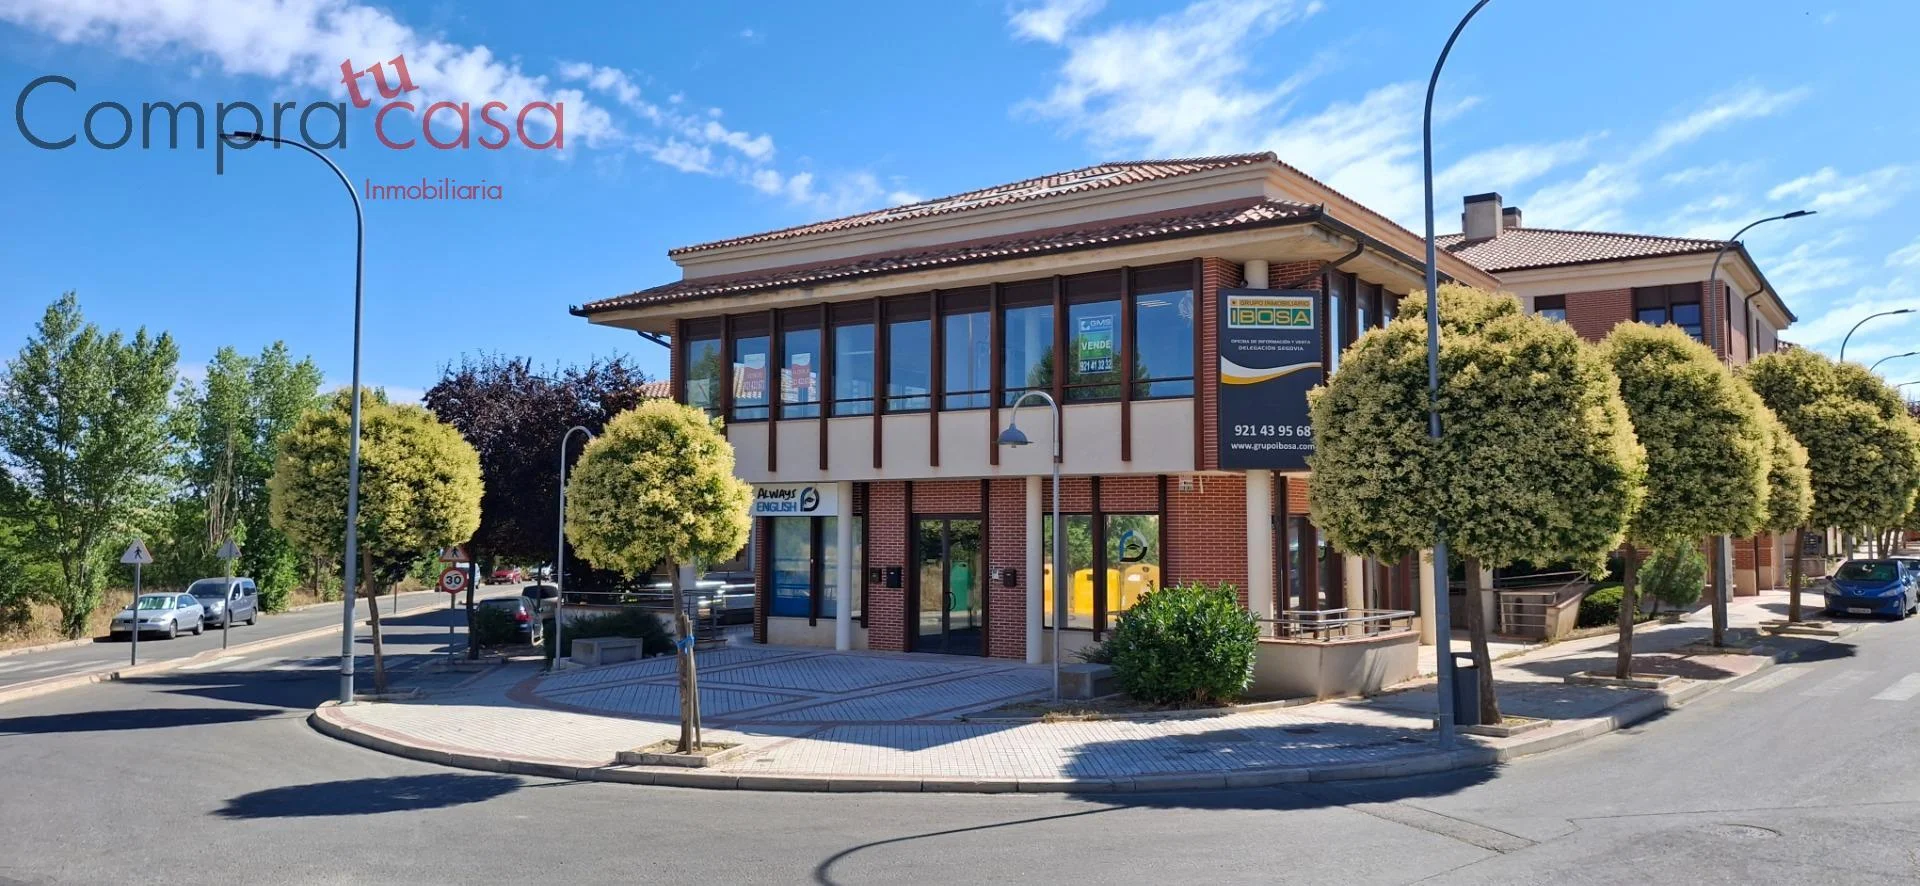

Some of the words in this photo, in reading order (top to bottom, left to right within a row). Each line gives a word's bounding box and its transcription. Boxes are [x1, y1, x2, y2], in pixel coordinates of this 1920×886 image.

[1231, 309, 1310, 325] IBOSA
[1081, 340, 1111, 350] VENDE
[1234, 424, 1257, 437] 921
[1260, 424, 1275, 437] 43
[1278, 425, 1293, 437] 95
[1296, 425, 1312, 437] 68
[1231, 442, 1315, 451] www.grupoibosa.com
[756, 501, 798, 512] ENGLISH
[446, 575, 462, 585] 30
